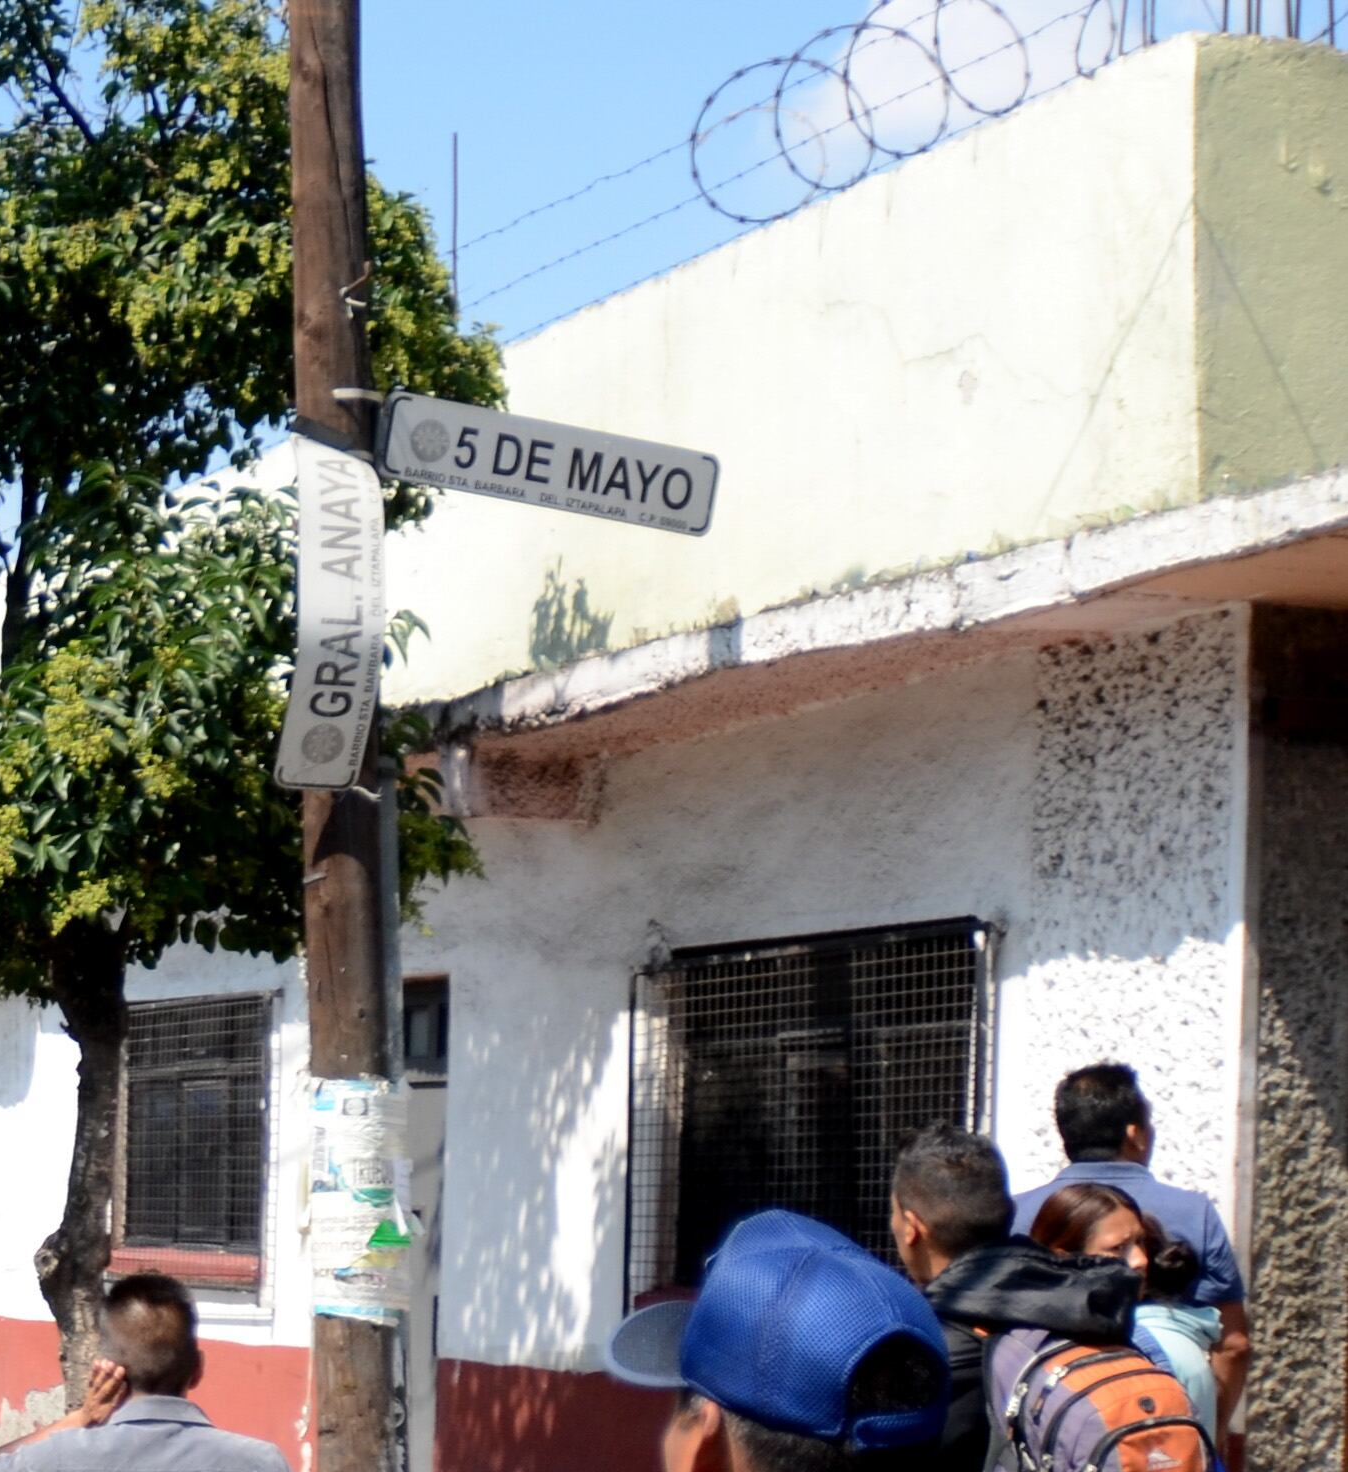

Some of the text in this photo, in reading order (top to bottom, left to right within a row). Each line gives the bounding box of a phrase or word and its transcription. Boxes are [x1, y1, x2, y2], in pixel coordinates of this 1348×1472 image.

[404, 466, 446, 484] BARRIO
[473, 479, 527, 499] BARBARA
[566, 496, 627, 518] IZTAPALAPA
[454, 426, 694, 512] 5 DE MAYO
[308, 457, 364, 719] GRAL. ANAYA
[348, 723, 367, 768] BARRIO
[363, 632, 381, 694] BARBARA
